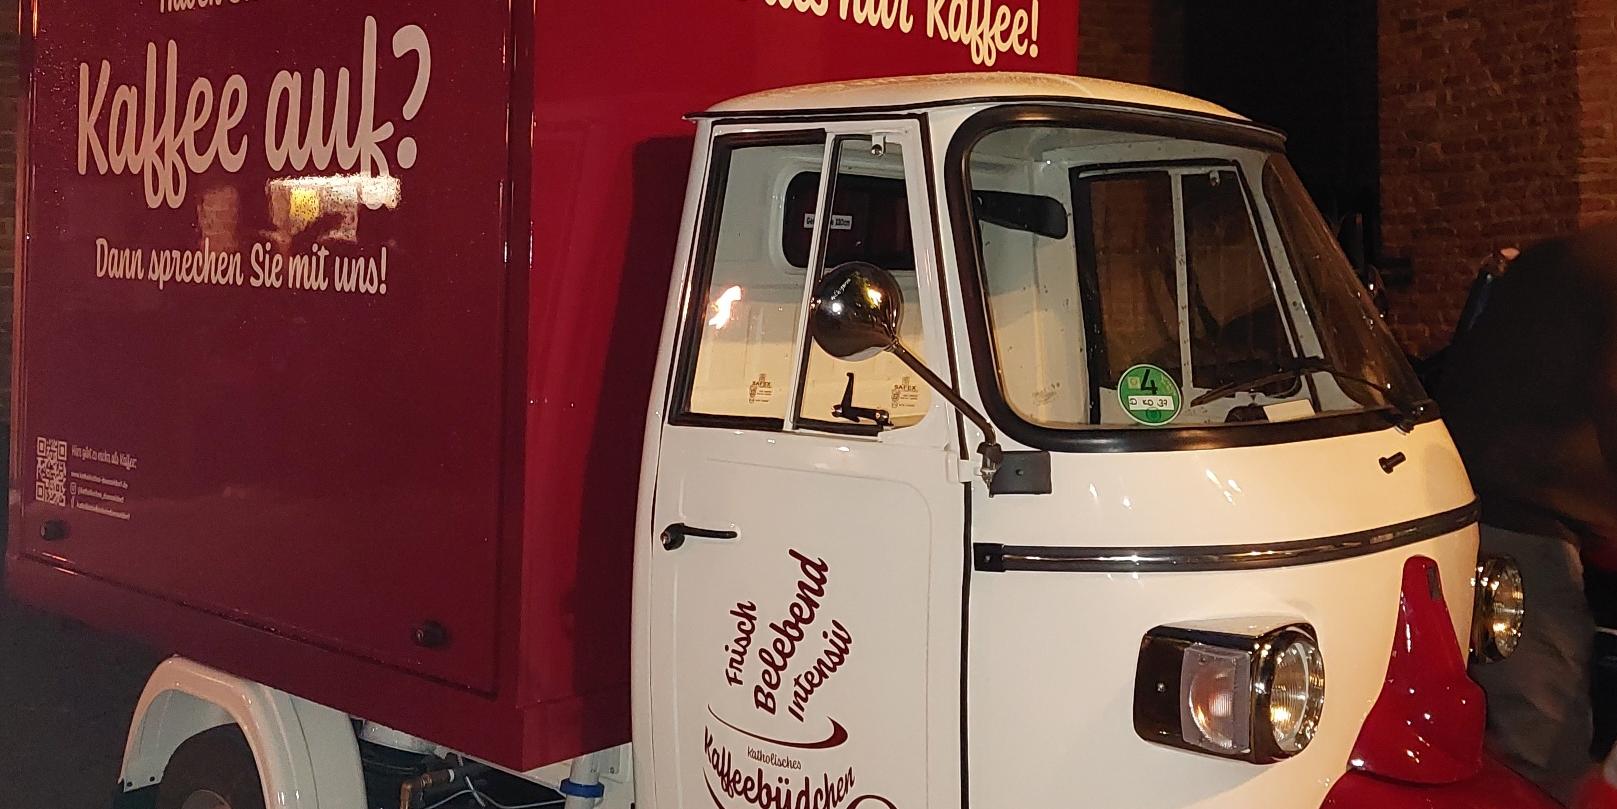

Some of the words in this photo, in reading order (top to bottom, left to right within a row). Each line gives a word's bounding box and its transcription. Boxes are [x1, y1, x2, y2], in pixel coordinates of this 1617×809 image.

[926, 0, 1039, 66] Kaffee!
[77, 39, 249, 208] Kaffee
[264, 15, 432, 210] auf?
[95, 238, 145, 279] Dann
[147, 239, 245, 290] sprechen
[249, 242, 283, 288] Sie
[287, 246, 329, 292] mit
[334, 246, 388, 294] uns!
[1140, 369, 1158, 395] 4
[725, 600, 758, 687] Frisch
[753, 548, 829, 716] Belebend
[788, 619, 853, 723] Intensiv
[703, 725, 856, 809] Kaffeebüdchen
